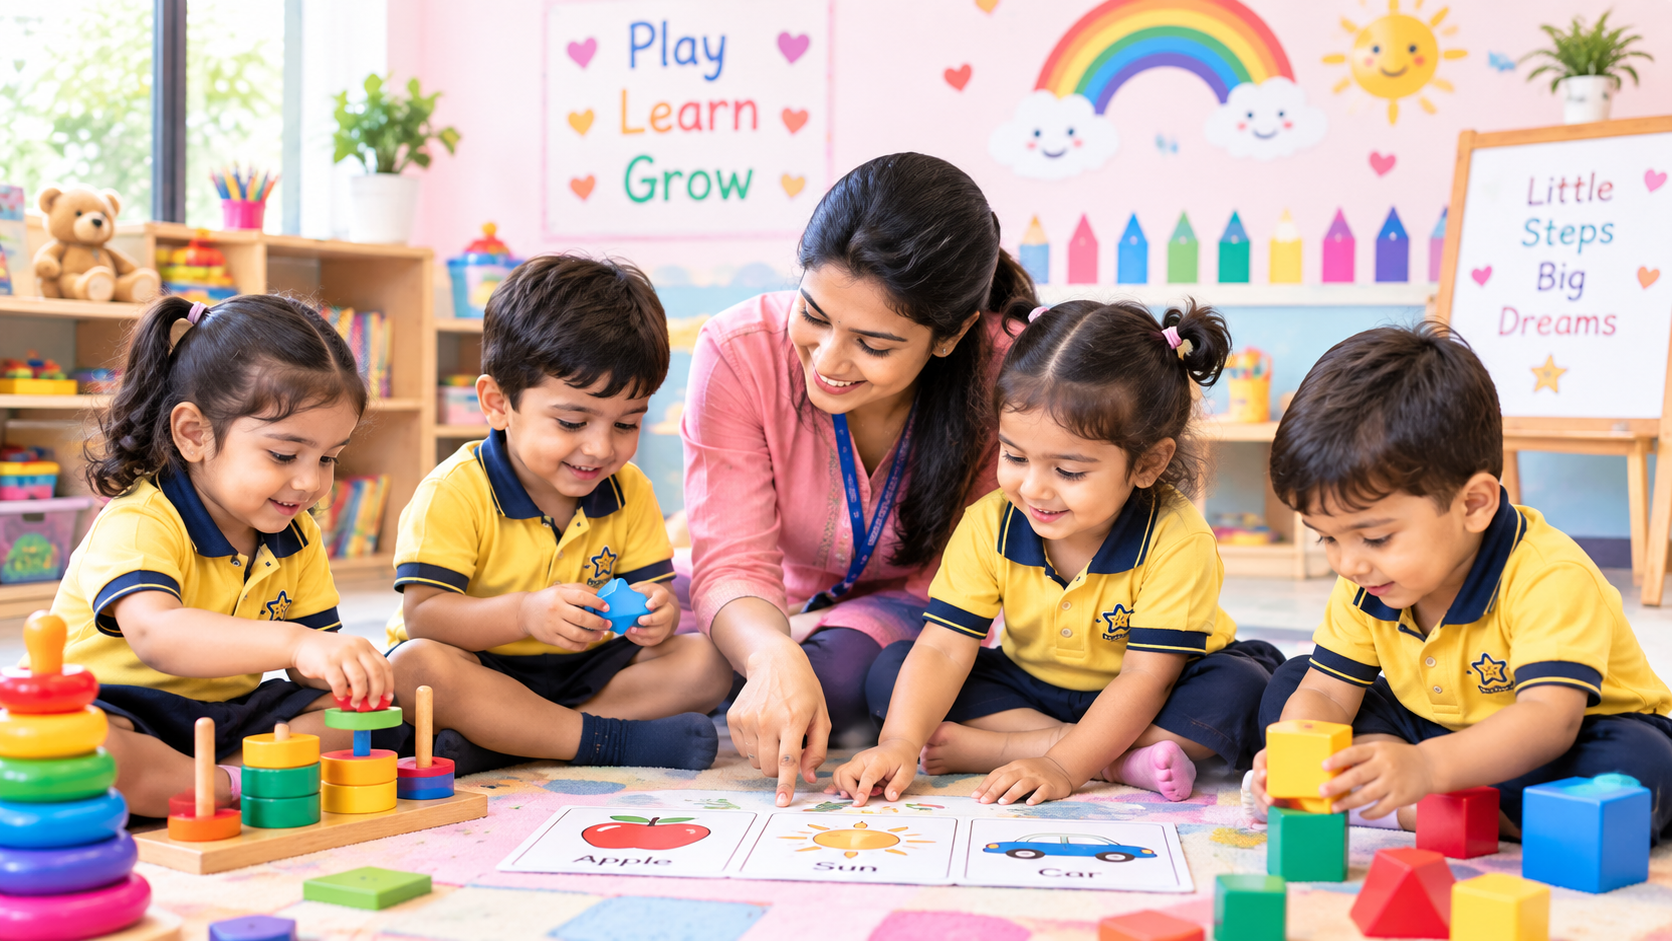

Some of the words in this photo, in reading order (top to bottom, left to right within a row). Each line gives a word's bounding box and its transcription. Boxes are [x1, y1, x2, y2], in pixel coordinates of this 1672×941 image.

[628, 20, 726, 82] Play
[621, 88, 758, 135] Learn
[623, 154, 754, 204] Grow
[1528, 171, 1614, 207] Little
[1521, 217, 1615, 255] Steps
[1537, 261, 1586, 302] Big
[1499, 306, 1617, 337] Dreams
[572, 854, 673, 867] Apple
[813, 861, 878, 873] Sun
[1038, 867, 1103, 879] Car
